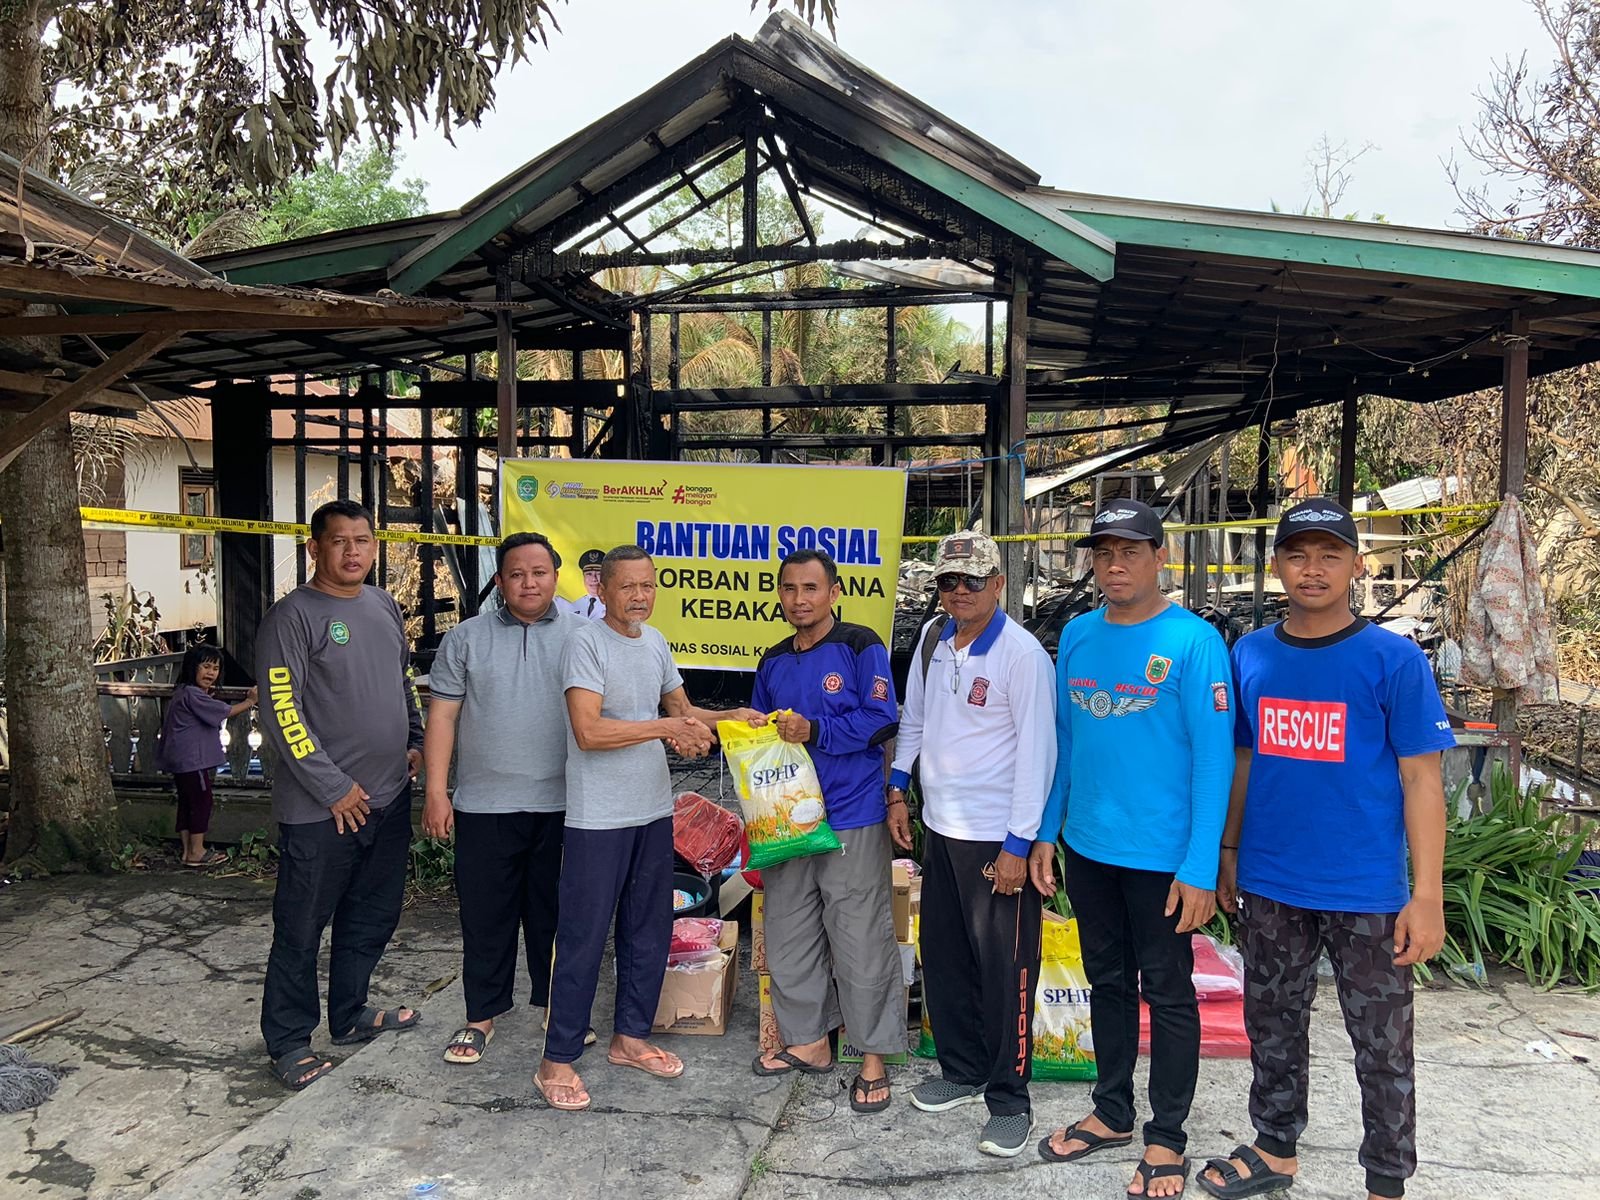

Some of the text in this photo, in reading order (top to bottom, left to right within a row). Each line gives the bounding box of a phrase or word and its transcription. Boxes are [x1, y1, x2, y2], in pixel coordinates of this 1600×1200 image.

[603, 484, 664, 496] BerAKHLAK
[685, 485, 712, 493] bangga
[685, 492, 717, 500] melayani
[197, 517, 221, 525] DILARANG
[637, 521, 881, 564] BANTUAN SOSIAL
[701, 643, 750, 656] SOSIAL
[269, 666, 316, 760] DINSOS
[1263, 707, 1341, 751] RESCUE
[753, 762, 800, 786] SPHP
[1015, 967, 1029, 1077] SPORT
